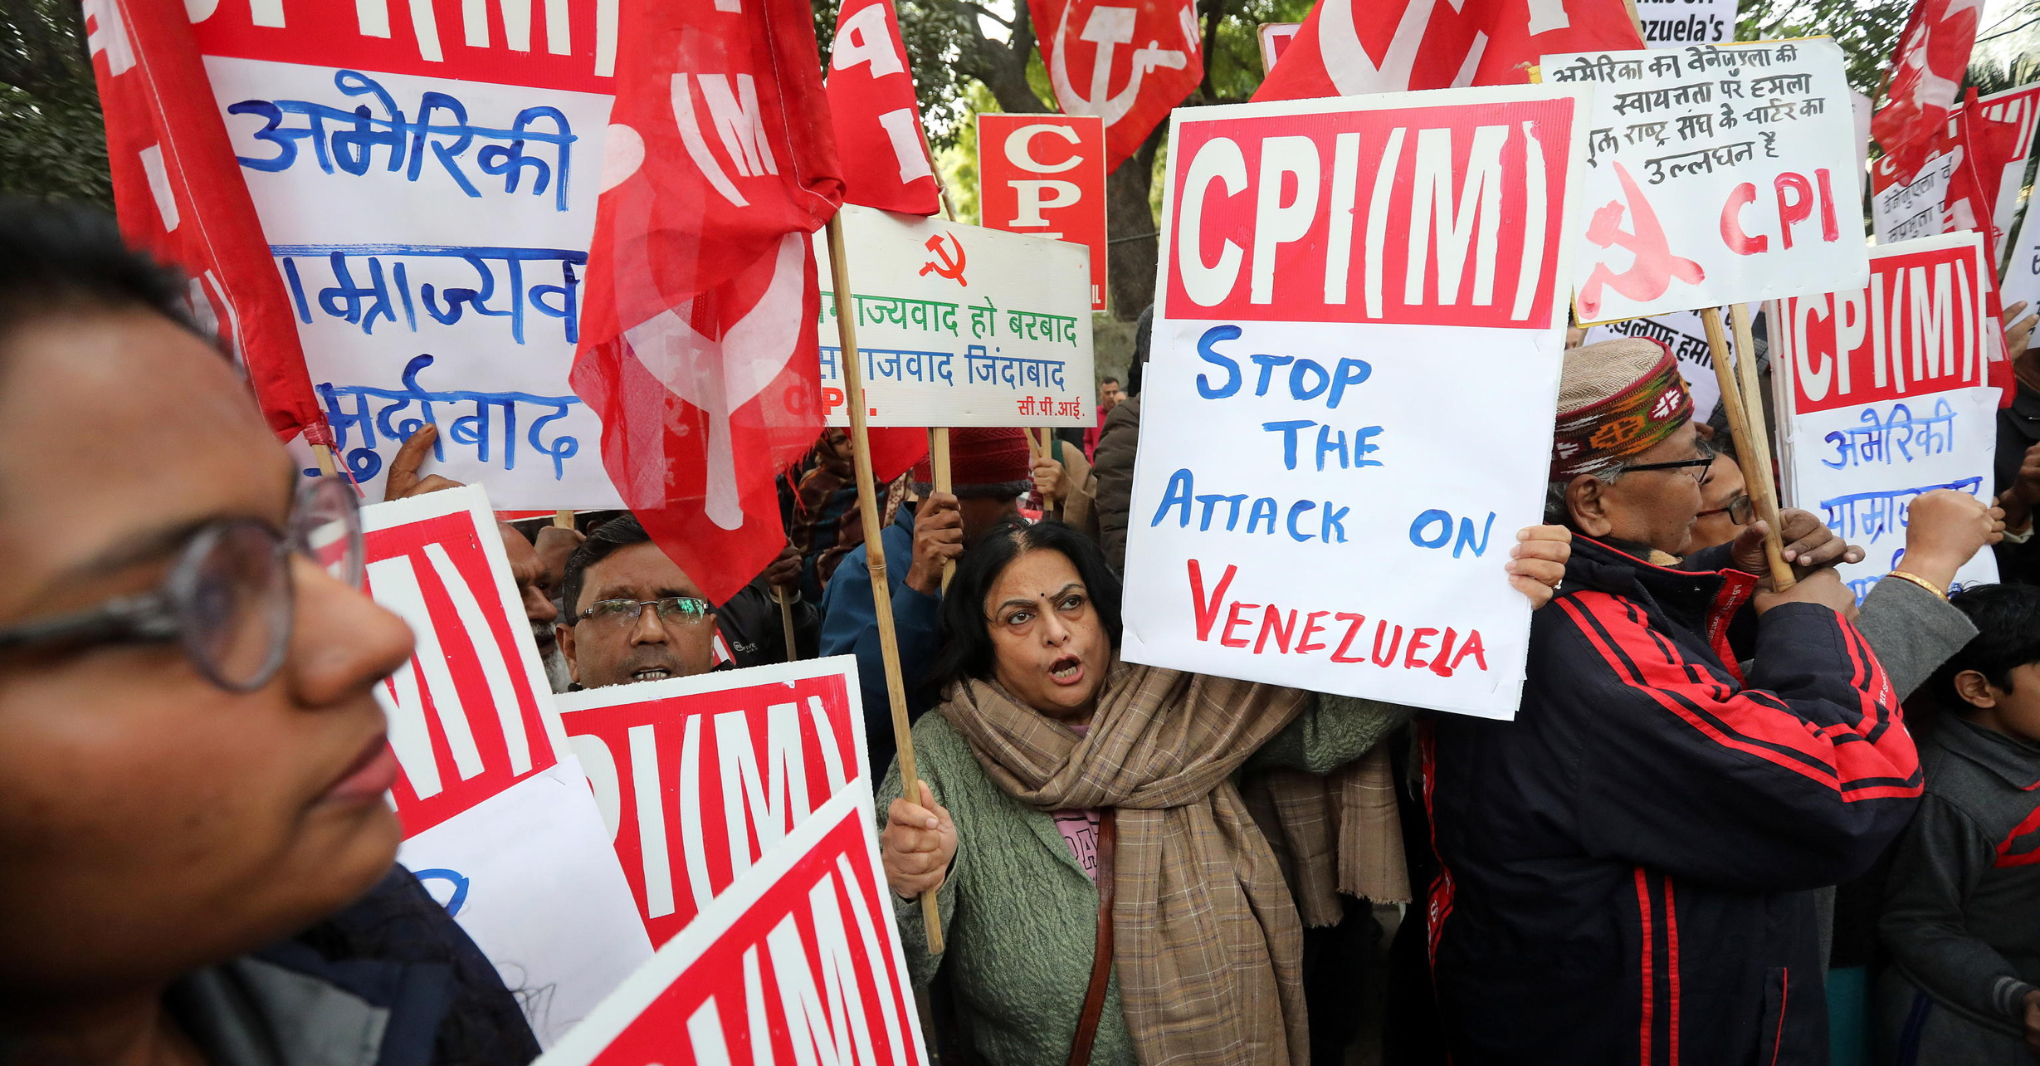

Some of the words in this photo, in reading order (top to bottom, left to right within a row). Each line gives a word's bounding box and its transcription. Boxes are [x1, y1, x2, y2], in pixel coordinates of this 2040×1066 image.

[1640, 14, 1724, 42] zuela's
[1648, 55, 1682, 79] का
[1776, 44, 1798, 63] की
[1751, 73, 1813, 98] हमला
[228, 70, 578, 212] अमेरिकी
[1675, 109, 1714, 141] संघ
[1719, 103, 1738, 129] के
[1743, 98, 1798, 124] चार्टर
[1799, 98, 1826, 117] का
[1758, 131, 1780, 158] है
[1004, 124, 1084, 240] CP
[1720, 168, 1839, 255] CPI
[1178, 121, 1548, 321] CPI(M)
[967, 296, 998, 340] हो
[1007, 309, 1078, 347] बरबाद
[1793, 258, 1975, 402] CPI(M)
[964, 344, 1066, 393] जिंदाबाद
[1196, 325, 1372, 409] STOP
[1017, 396, 1086, 420] सी.पी.आई.
[1821, 397, 1957, 470] अमेरिकी
[1262, 420, 1385, 471] THE
[1151, 468, 1349, 543] ATTACK
[1408, 508, 1497, 559] ON
[1187, 558, 1488, 678] VENEZUELA
